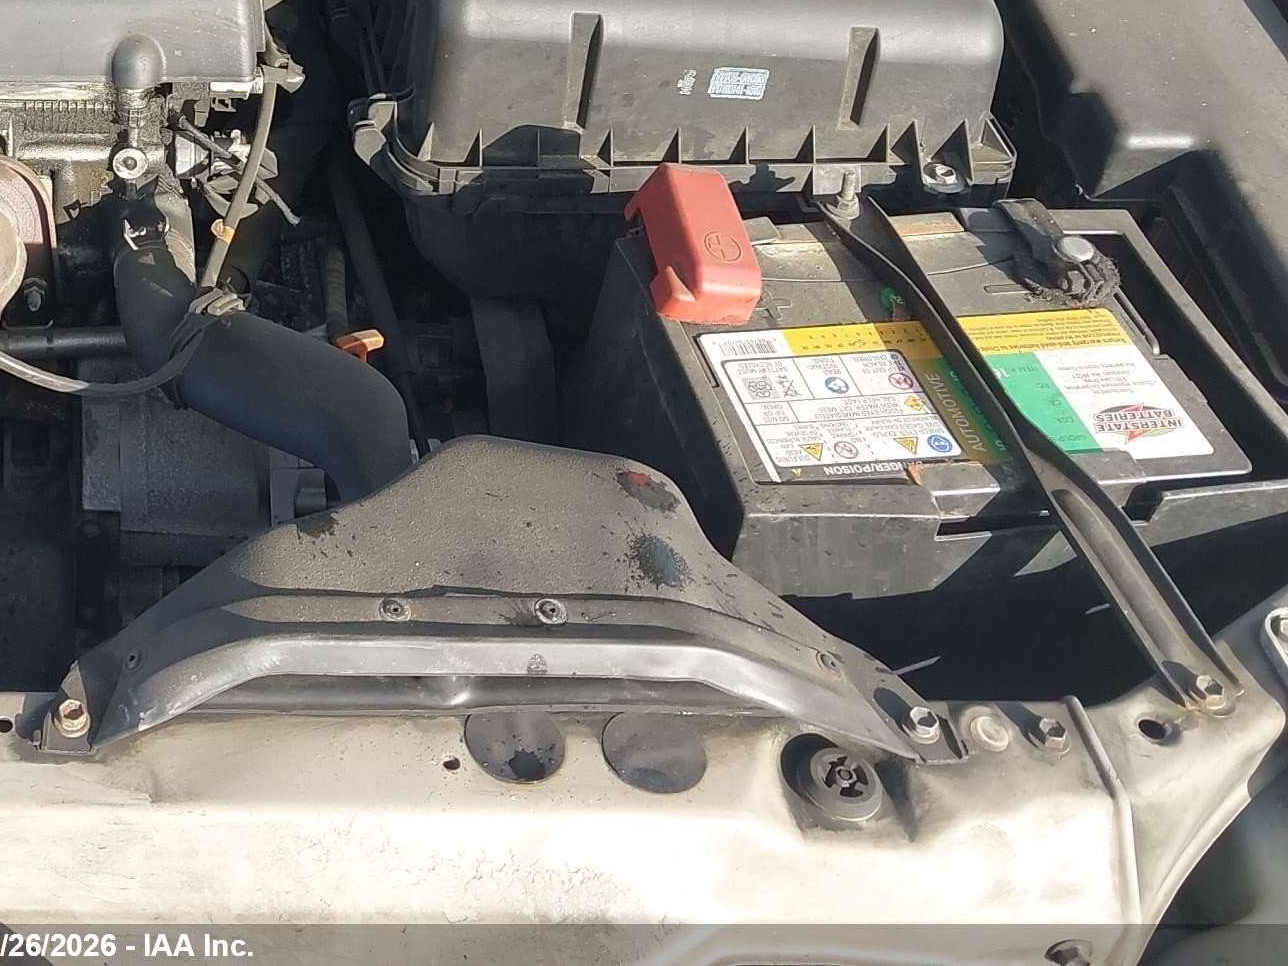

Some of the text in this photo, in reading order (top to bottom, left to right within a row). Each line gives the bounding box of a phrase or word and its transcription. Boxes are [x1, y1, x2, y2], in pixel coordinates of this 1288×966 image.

[924, 373, 986, 452] AUTOMOTIVE
[1092, 408, 1175, 422] BATTERIES
[1093, 417, 1185, 432] INTERSTATE
